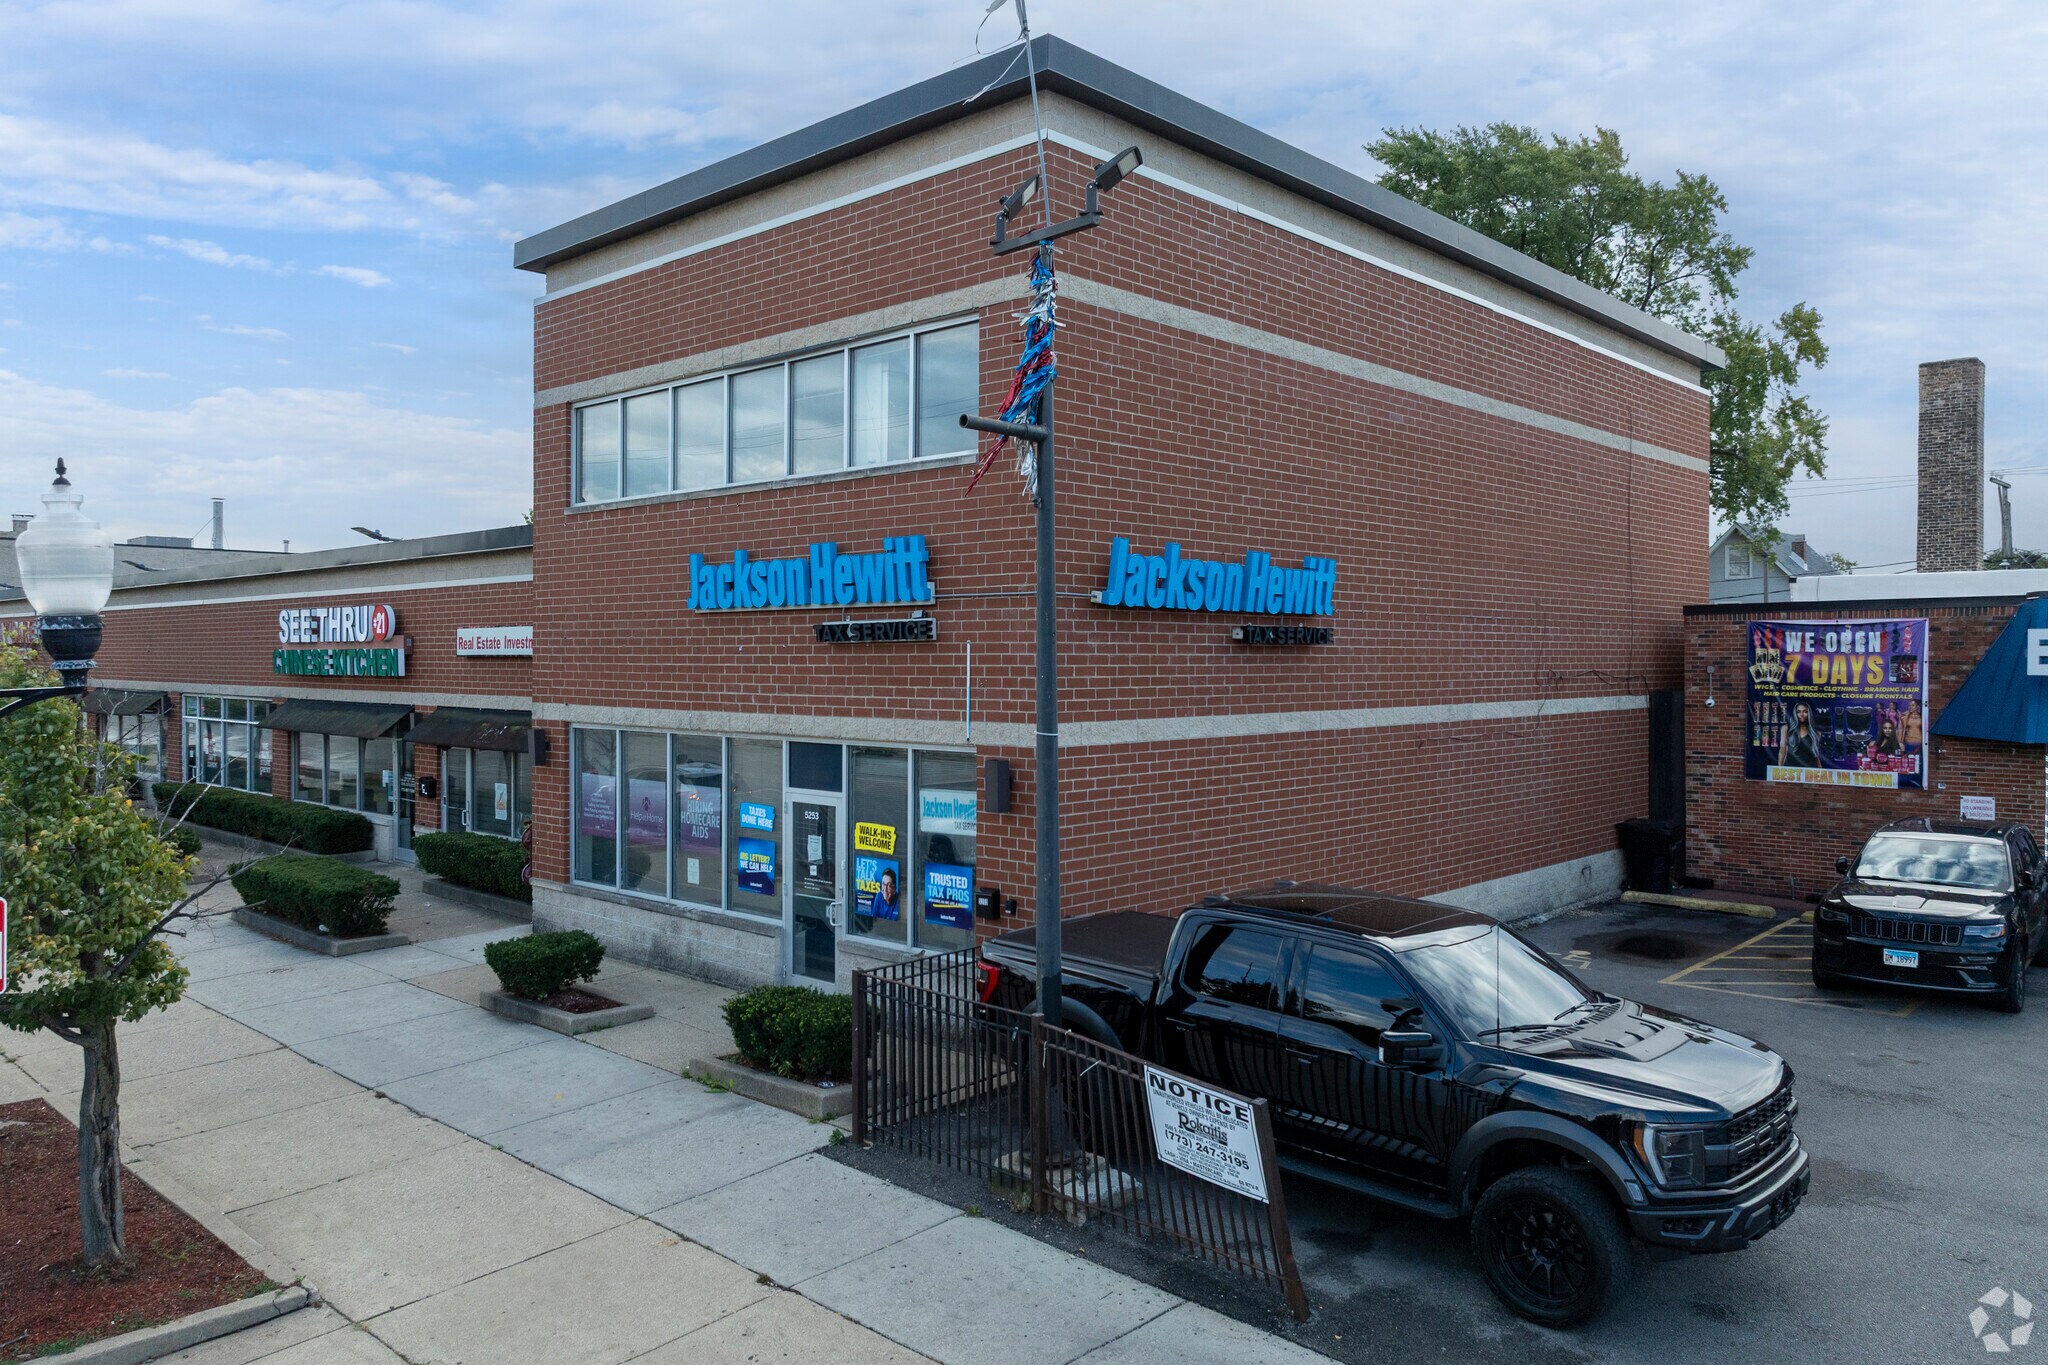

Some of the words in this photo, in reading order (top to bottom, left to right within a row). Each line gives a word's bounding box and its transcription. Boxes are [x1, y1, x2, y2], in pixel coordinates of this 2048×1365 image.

[687, 549, 811, 610] Jackson
[809, 535, 931, 604] Hewitt
[1102, 537, 1246, 611] Jackson
[1245, 550, 1337, 616] Hewitt
[813, 624, 849, 642] TAX
[849, 619, 932, 641] SERVICE
[1247, 626, 1273, 644] TAX
[1278, 627, 1334, 644] SERVICE
[458, 636, 474, 650] Real
[476, 636, 501, 650] Estate
[1785, 631, 1815, 653] WE
[1825, 631, 1881, 653] OPEN
[273, 648, 330, 676] CHINESE
[333, 648, 400, 677] KITCHEN
[1785, 655, 1800, 683] 7
[1812, 654, 1884, 685] DAYS
[1772, 768, 1803, 781] BEST
[1805, 770, 1835, 784] DEAL
[1837, 771, 1850, 784] IN
[1852, 772, 1893, 787] TOWN
[687, 800, 714, 815] HIRING
[748, 806, 766, 817] TAXES
[804, 811, 819, 820] 5253
[923, 797, 953, 818] Jackson
[681, 811, 720, 828] HOMECARE
[741, 814, 757, 825] DONE
[757, 816, 773, 829] HERE
[691, 826, 709, 839] AIDS
[859, 825, 891, 840] WALK-INS
[859, 836, 891, 851] WELCOME
[740, 860, 748, 869] WE
[749, 861, 759, 871] CAN
[760, 863, 773, 873] HELP
[749, 853, 770, 864] LETTER?
[856, 857, 877, 872] LET'S
[856, 868, 876, 882] TALK
[930, 872, 967, 889] TRUSTED
[856, 879, 880, 893] TAXES
[928, 884, 944, 899] TAX
[946, 887, 970, 903] PROS
[1149, 1073, 1249, 1123] NOTICE
[1153, 1088, 1184, 1105] UNAUTHORIZED
[1185, 1100, 1204, 1113] VEHICLES
[1205, 1108, 1215, 1117] WILL
[1223, 1114, 1248, 1129] RELOCATED
[1171, 1102, 1188, 1113] VEHICLE
[1209, 1116, 1228, 1128] EXPENSE
[1176, 1110, 1228, 1146] Rokaitis
[1165, 1129, 1192, 1148] (773)
[1196, 1141, 1249, 1171] 247-3195
[1165, 1149, 1175, 1158] CASH
[1193, 1161, 1223, 1177] MASTERCARD
